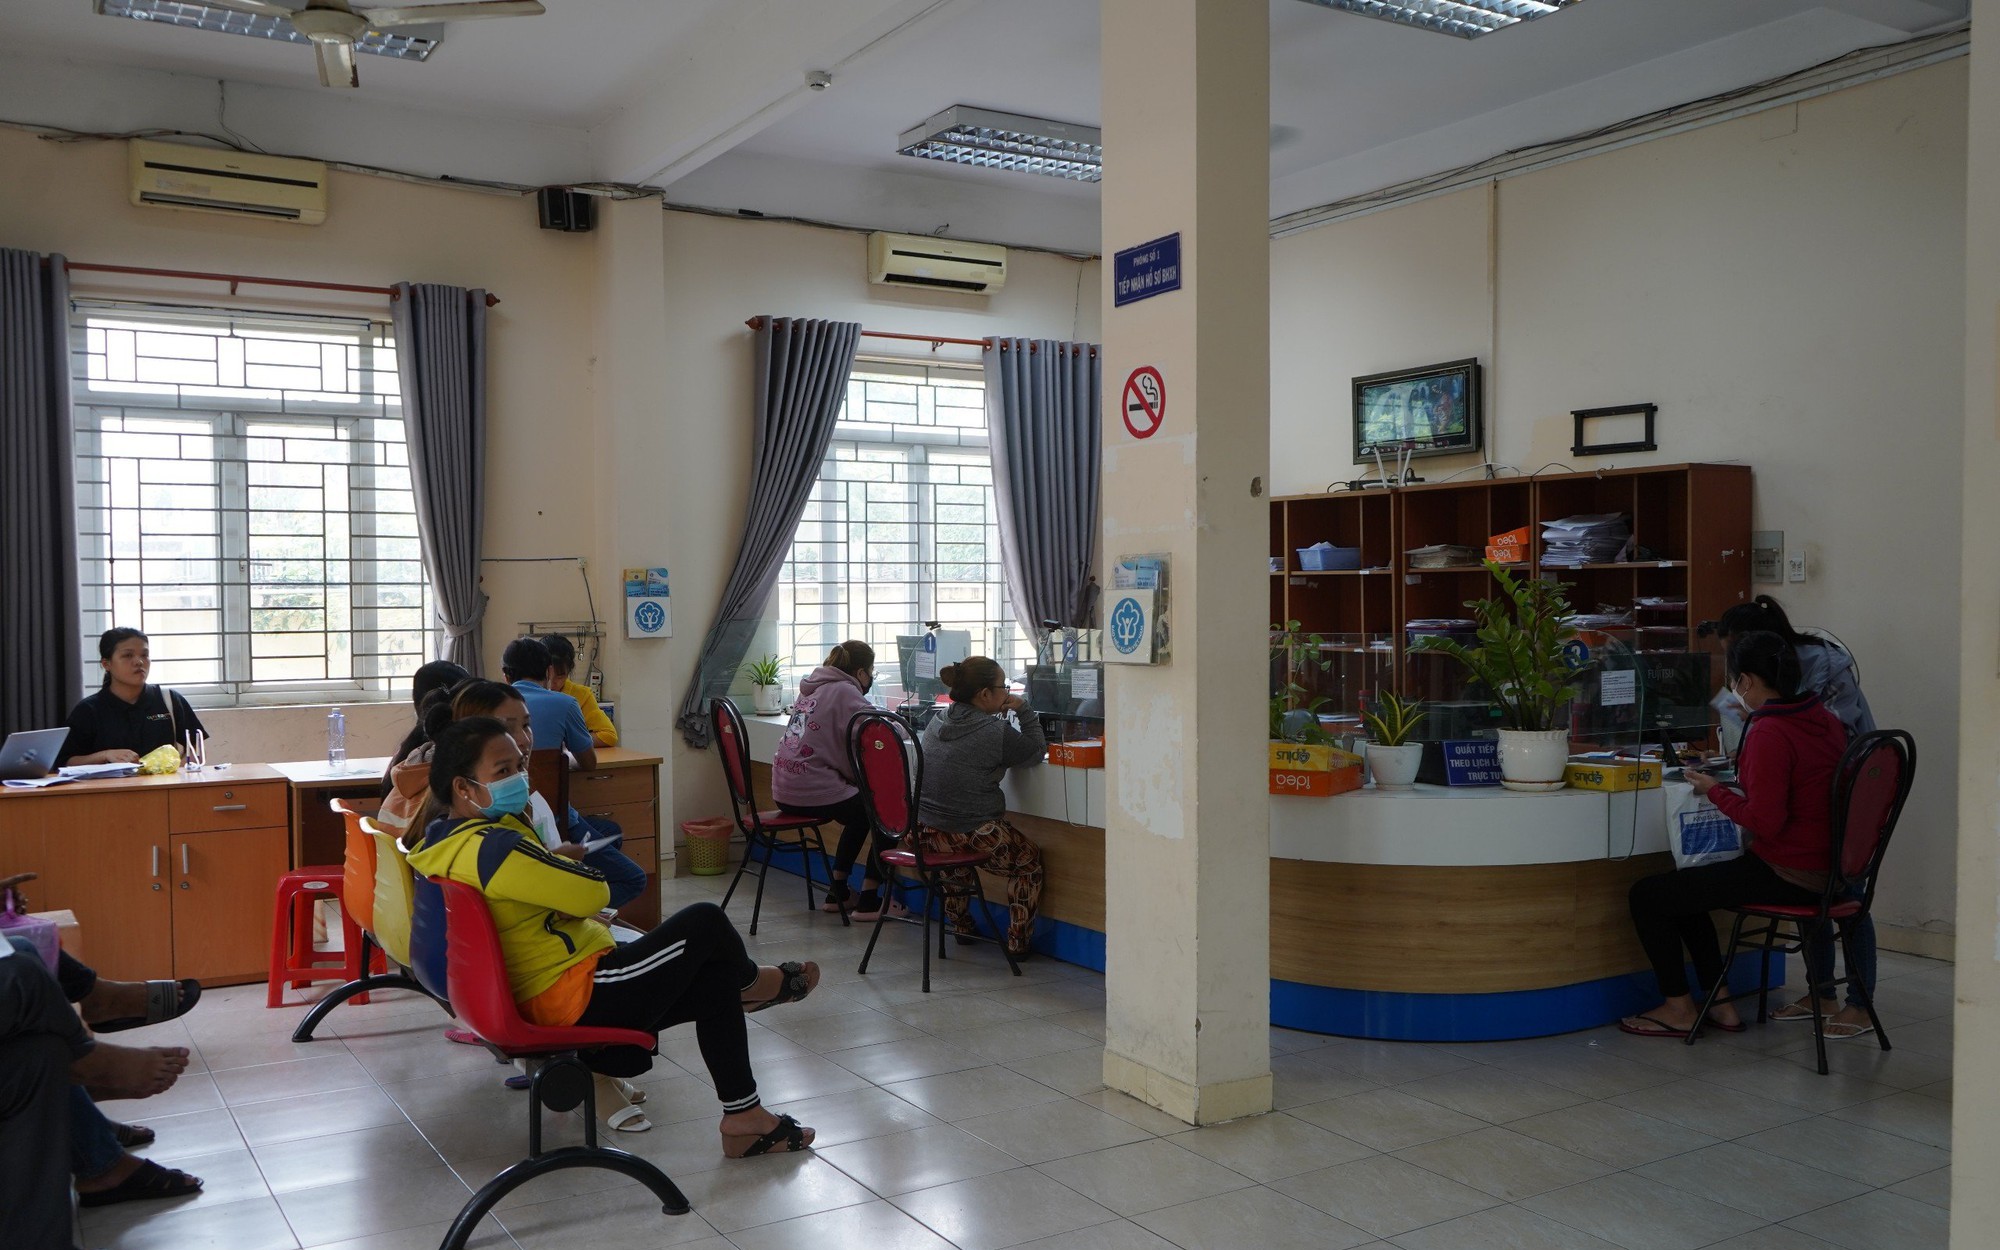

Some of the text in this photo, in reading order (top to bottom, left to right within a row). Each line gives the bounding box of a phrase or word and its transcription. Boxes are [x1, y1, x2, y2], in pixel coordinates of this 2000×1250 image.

[1149, 248, 1156, 262] SỐ
[1156, 250, 1160, 260] 1
[1118, 265, 1177, 295] TIẾP NHẬN HỒ SƠ BHXH
[928, 636, 932, 651] 1
[1066, 641, 1073, 658] 2
[1647, 668, 1674, 681] FUJITSU
[1477, 743, 1495, 754] TIẾP
[1449, 759, 1471, 768] THEO
[1472, 759, 1491, 769] LỊCH
[1467, 771, 1489, 782] TRỰC
